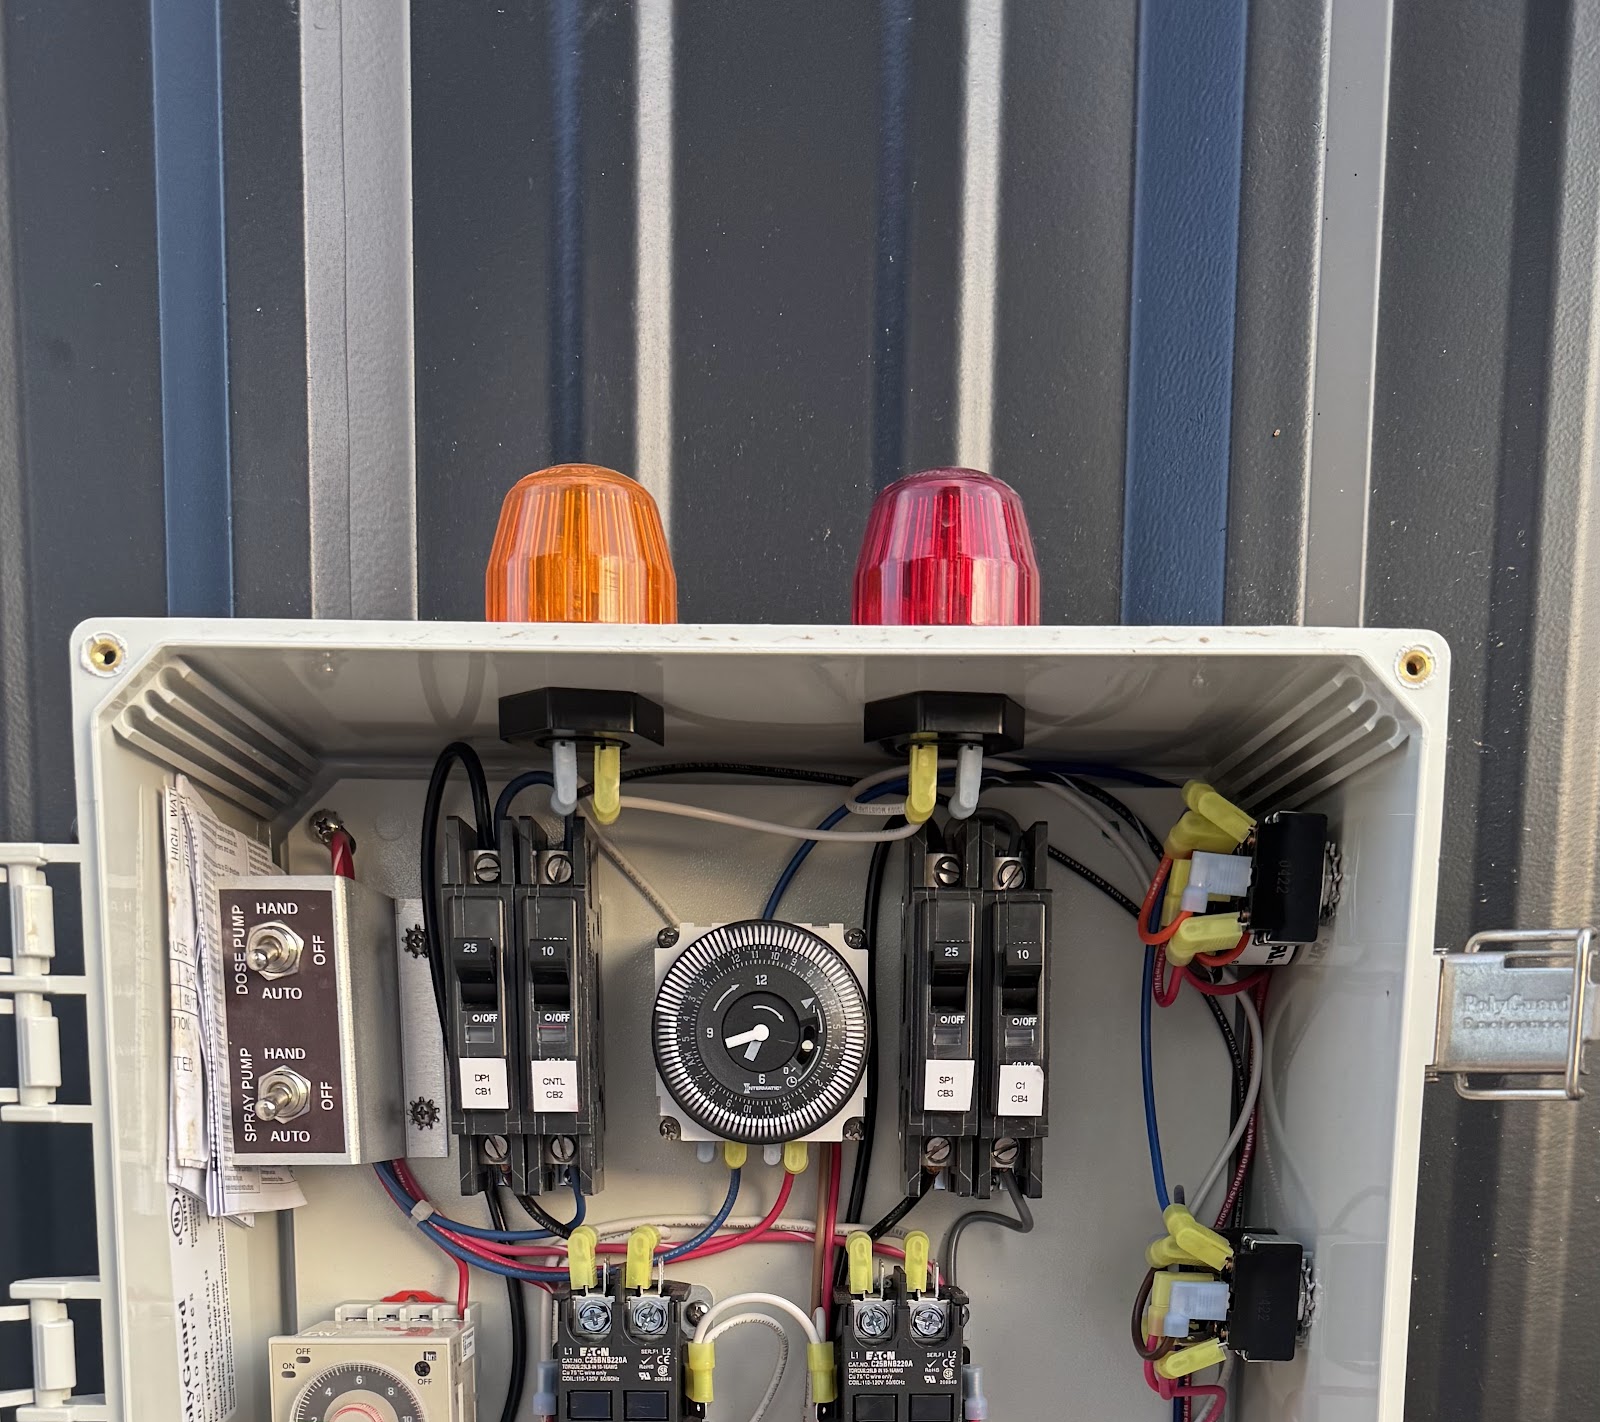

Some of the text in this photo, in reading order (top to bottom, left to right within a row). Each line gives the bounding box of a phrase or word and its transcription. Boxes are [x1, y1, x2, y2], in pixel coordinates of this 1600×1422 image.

[171, 828, 180, 861] HIGH
[256, 902, 299, 915] HAND
[231, 904, 249, 995] DOSE PUMP
[313, 935, 326, 965] OFF
[463, 943, 477, 953] 25
[541, 947, 554, 956] 10
[945, 947, 959, 957] 25
[731, 954, 740, 964] 12
[751, 951, 759, 959] 11
[771, 952, 780, 961] 10
[1016, 950, 1029, 959] 10
[790, 958, 798, 966] 9
[755, 975, 767, 985] 12
[262, 987, 303, 1000] AUTO
[706, 1027, 714, 1038] 9
[264, 1048, 306, 1060] HAND
[475, 1074, 490, 1082] DP1
[543, 1078, 565, 1086] CNTL
[758, 1074, 766, 1084] 6
[240, 1048, 258, 1142] SPRAY PUMP
[320, 1081, 334, 1111] OFF
[546, 1091, 563, 1099] CB2
[1011, 1095, 1028, 1103] CB4
[744, 1104, 752, 1113] 10
[765, 1106, 772, 1114] 11
[782, 1101, 792, 1111] 12
[270, 1130, 311, 1143] AUTO
[580, 1348, 609, 1356] EATON
[866, 1351, 895, 1360] EATON
[948, 1351, 957, 1359] L2
[657, 1356, 670, 1364] CE
[942, 1358, 955, 1368] CE
[356, 1376, 363, 1384] 6
[325, 1388, 333, 1396] 4
[387, 1388, 394, 1396] 8
